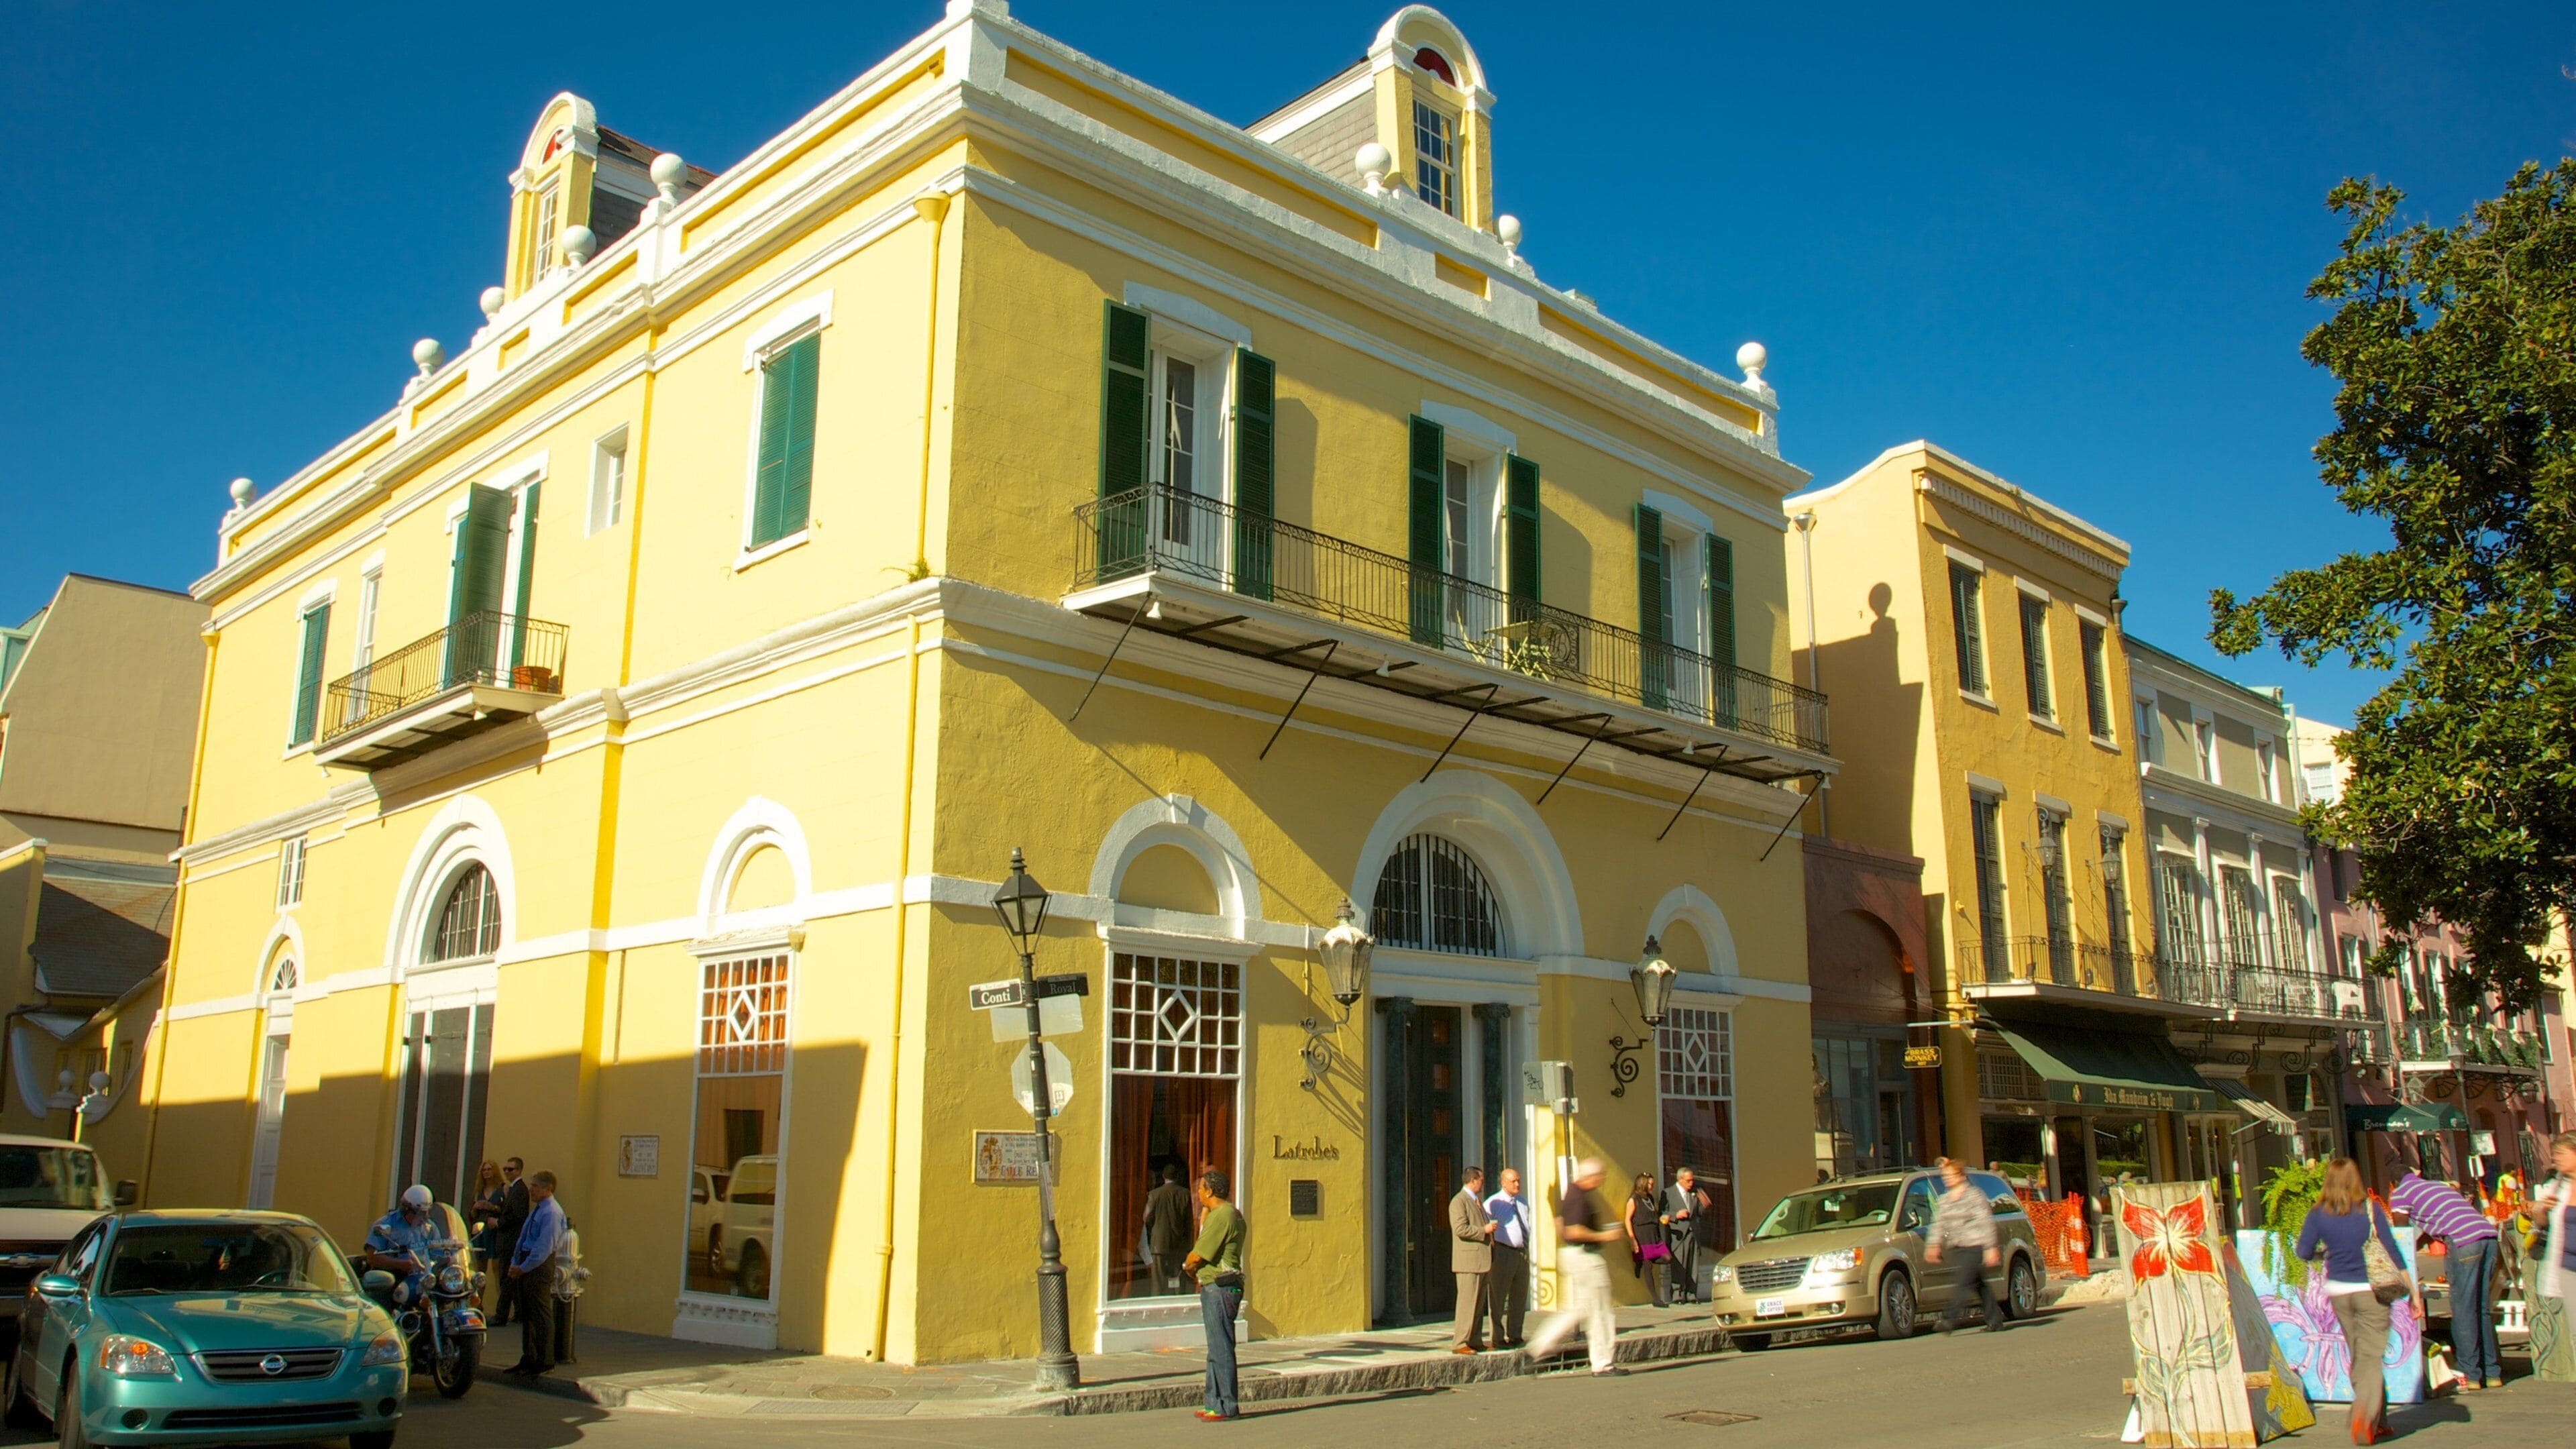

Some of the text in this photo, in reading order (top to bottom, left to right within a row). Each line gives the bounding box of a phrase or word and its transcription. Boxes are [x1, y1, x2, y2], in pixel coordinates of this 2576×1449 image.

[981, 989, 1011, 1005] Conti
[1904, 1054, 1938, 1062] MONKEY
[1273, 1134, 1338, 1159] Latrobe's
